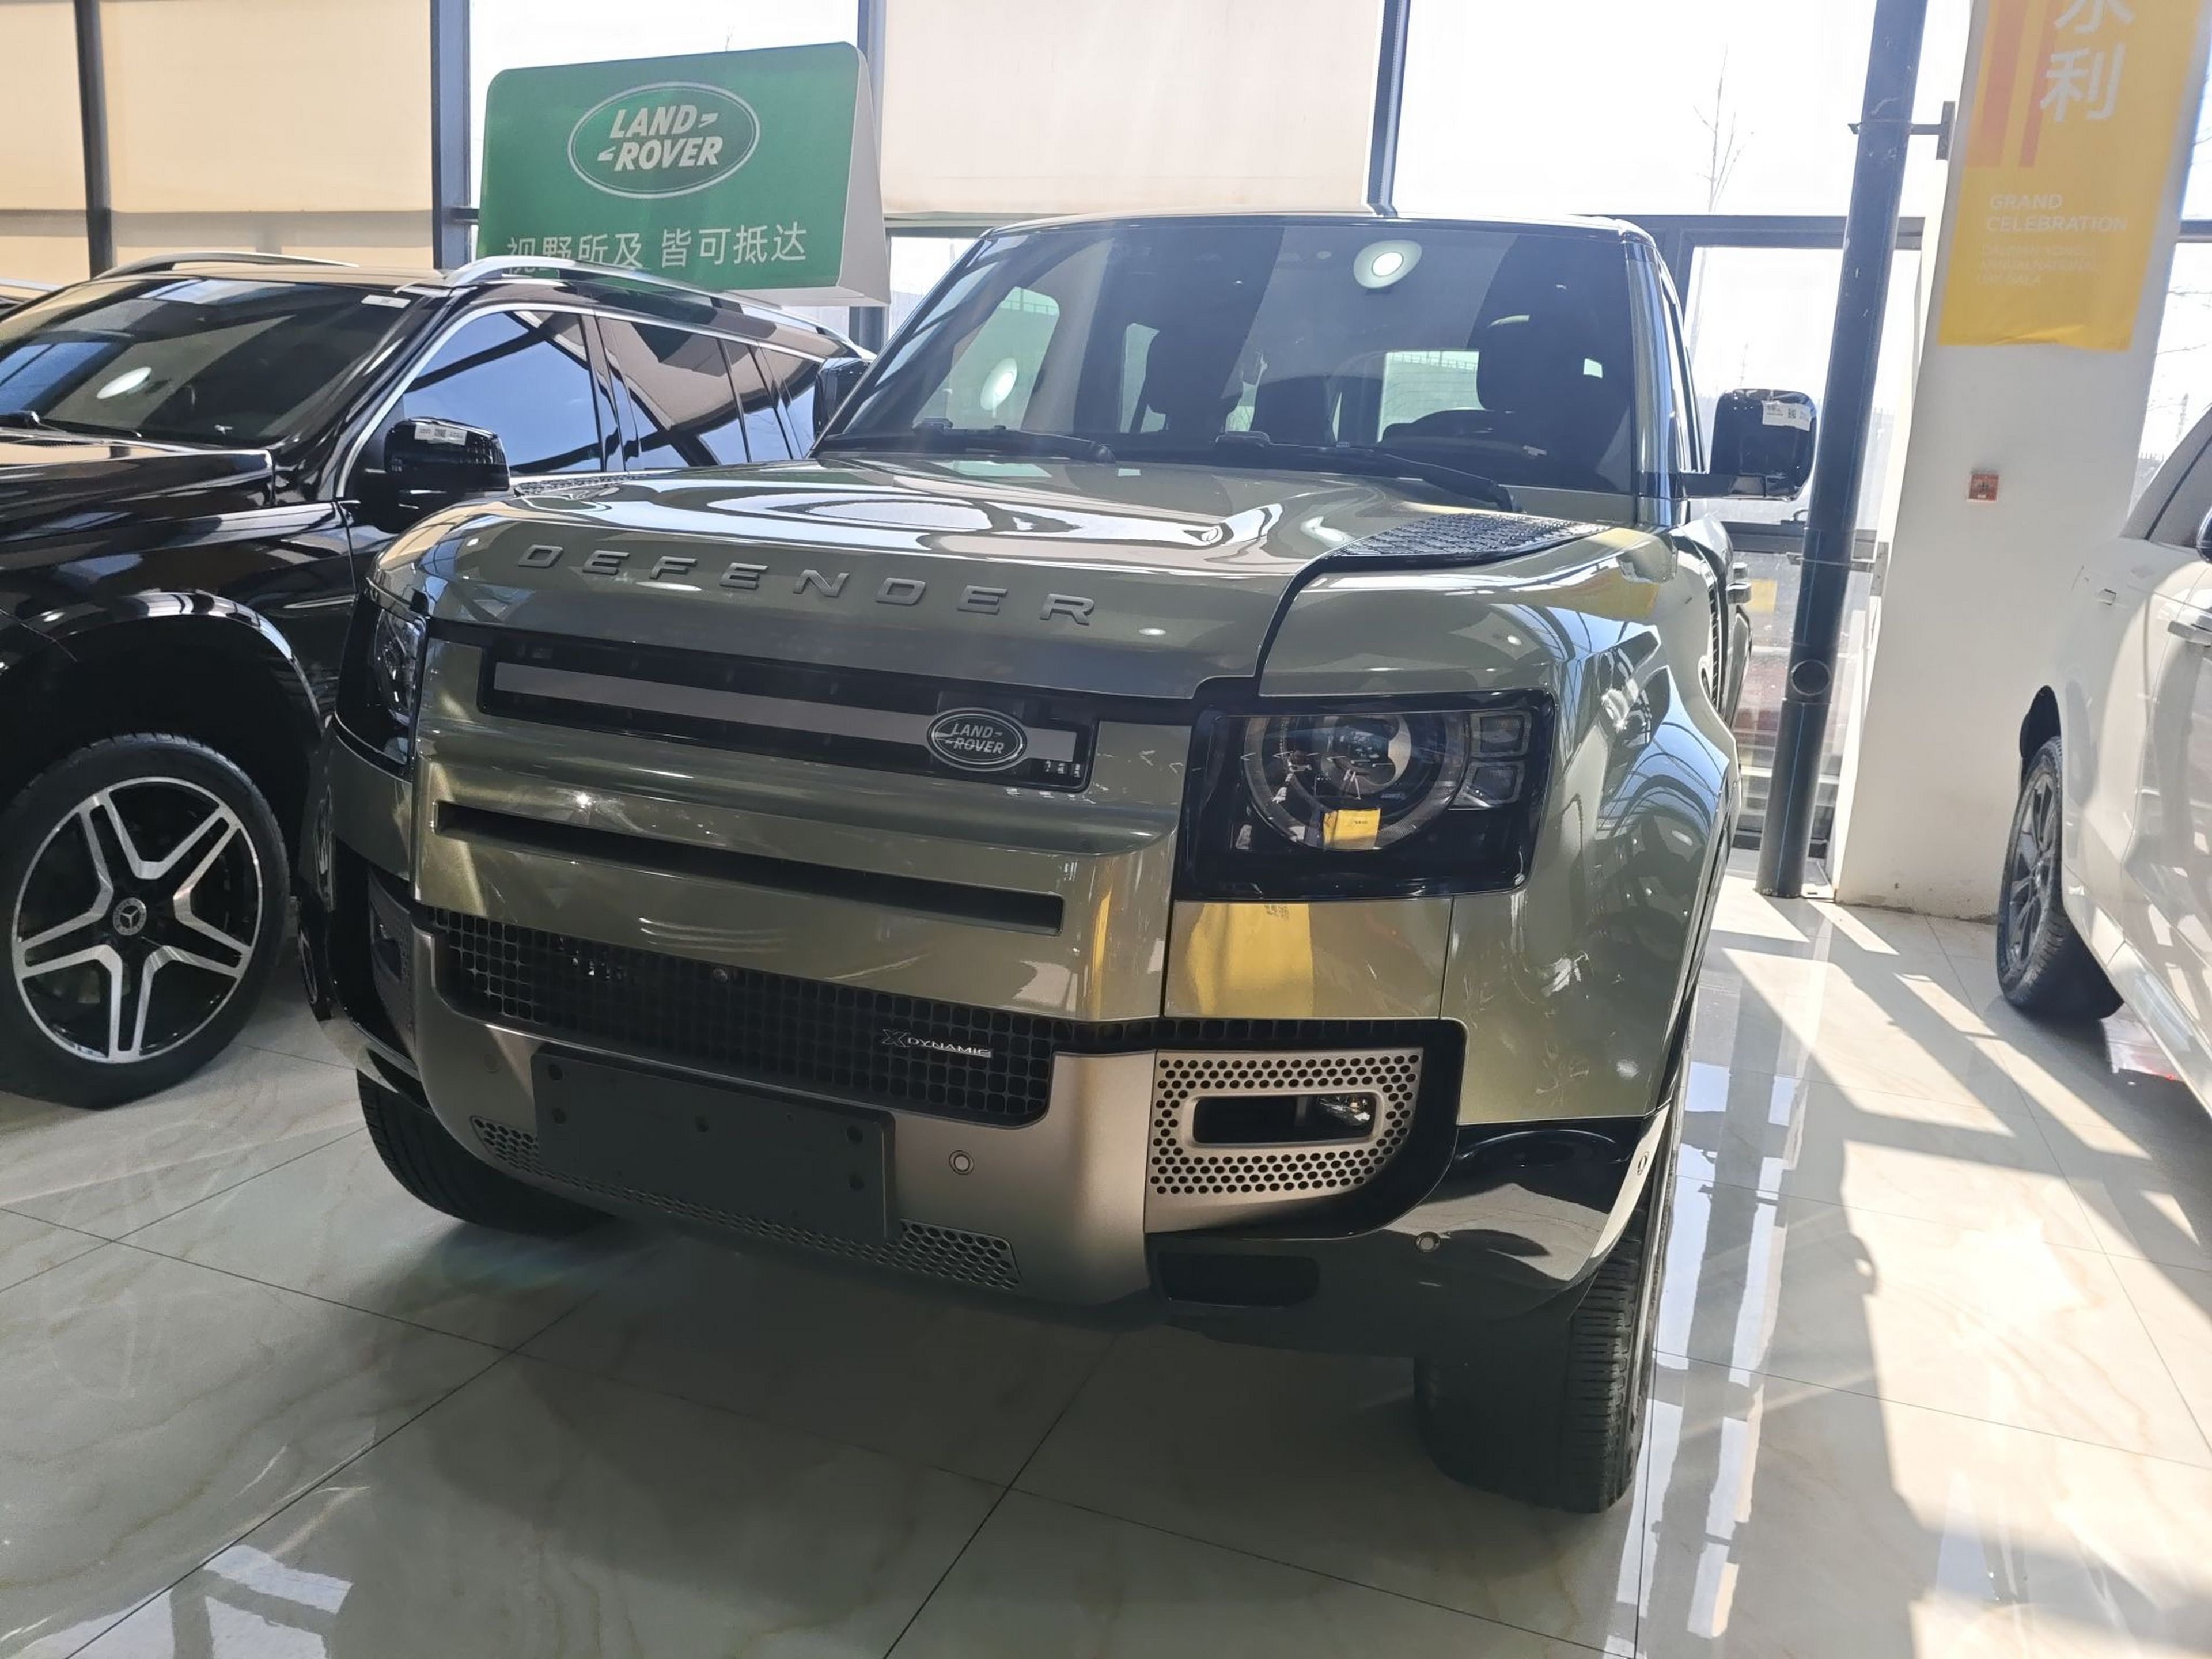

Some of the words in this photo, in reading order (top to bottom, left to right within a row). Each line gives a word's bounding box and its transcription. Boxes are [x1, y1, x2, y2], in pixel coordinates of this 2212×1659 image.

[609, 104, 698, 139] LAND
[613, 136, 724, 172] ROVER
[1989, 194, 2063, 210] GRAND
[1987, 215, 2127, 232] CELEBRATION
[661, 221, 806, 268] 皆可抵达
[517, 544, 1096, 626] DEFENDER
[950, 722, 993, 739] LAND
[952, 737, 1005, 755] ROVER
